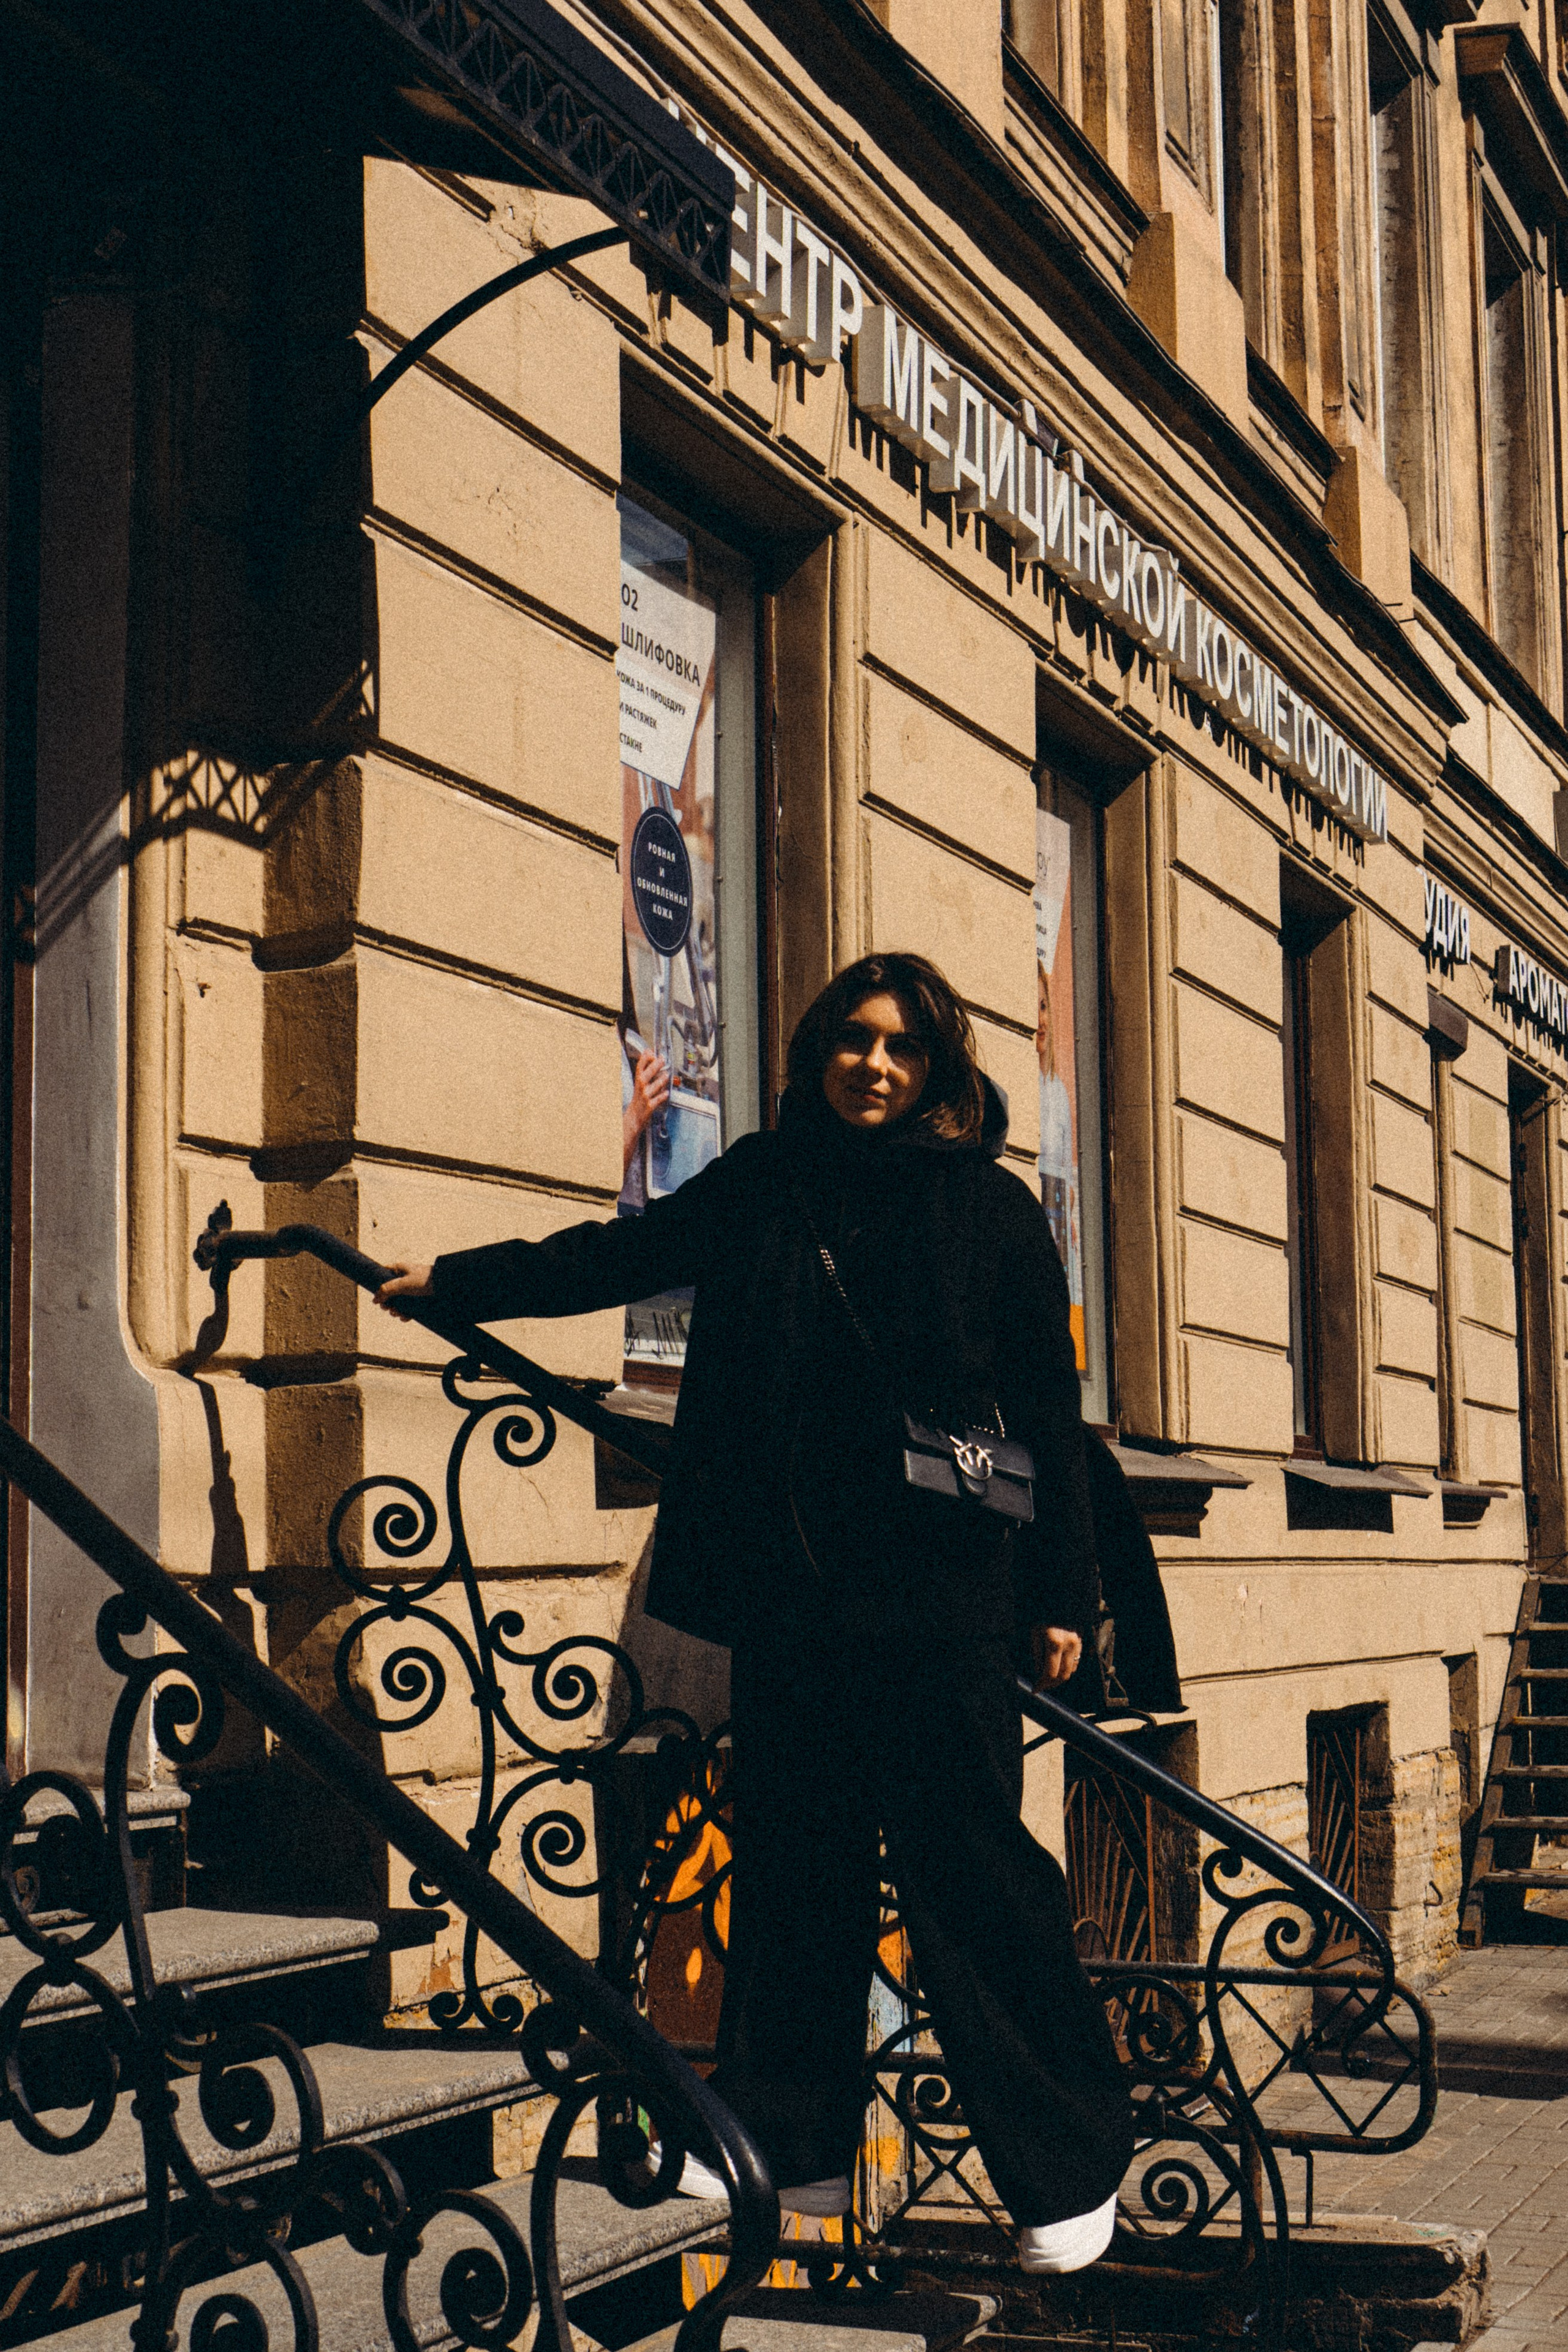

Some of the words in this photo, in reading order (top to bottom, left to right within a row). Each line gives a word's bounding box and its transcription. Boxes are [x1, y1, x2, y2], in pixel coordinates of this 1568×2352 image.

[669, 97, 863, 363] ЕНТР
[884, 304, 1185, 663] МЕДИЦИНСКОЙ
[1196, 599, 1387, 843] КОСМЕТОЛОГИИ
[622, 622, 701, 687] ШЛИФОВКА
[636, 680, 644, 694] ЗА
[650, 688, 685, 715] ПРОЦЕДУРУ
[625, 704, 657, 730] РАСТЯЖЕК
[648, 842, 676, 863] РОВНАЯ
[659, 867, 665, 878] И
[637, 877, 687, 907] ОБНОВЛЕННАЯ
[652, 903, 673, 921] КОЖА
[1415, 865, 1470, 965] УДИЯ
[1509, 944, 1568, 1036] АРОМАТ
